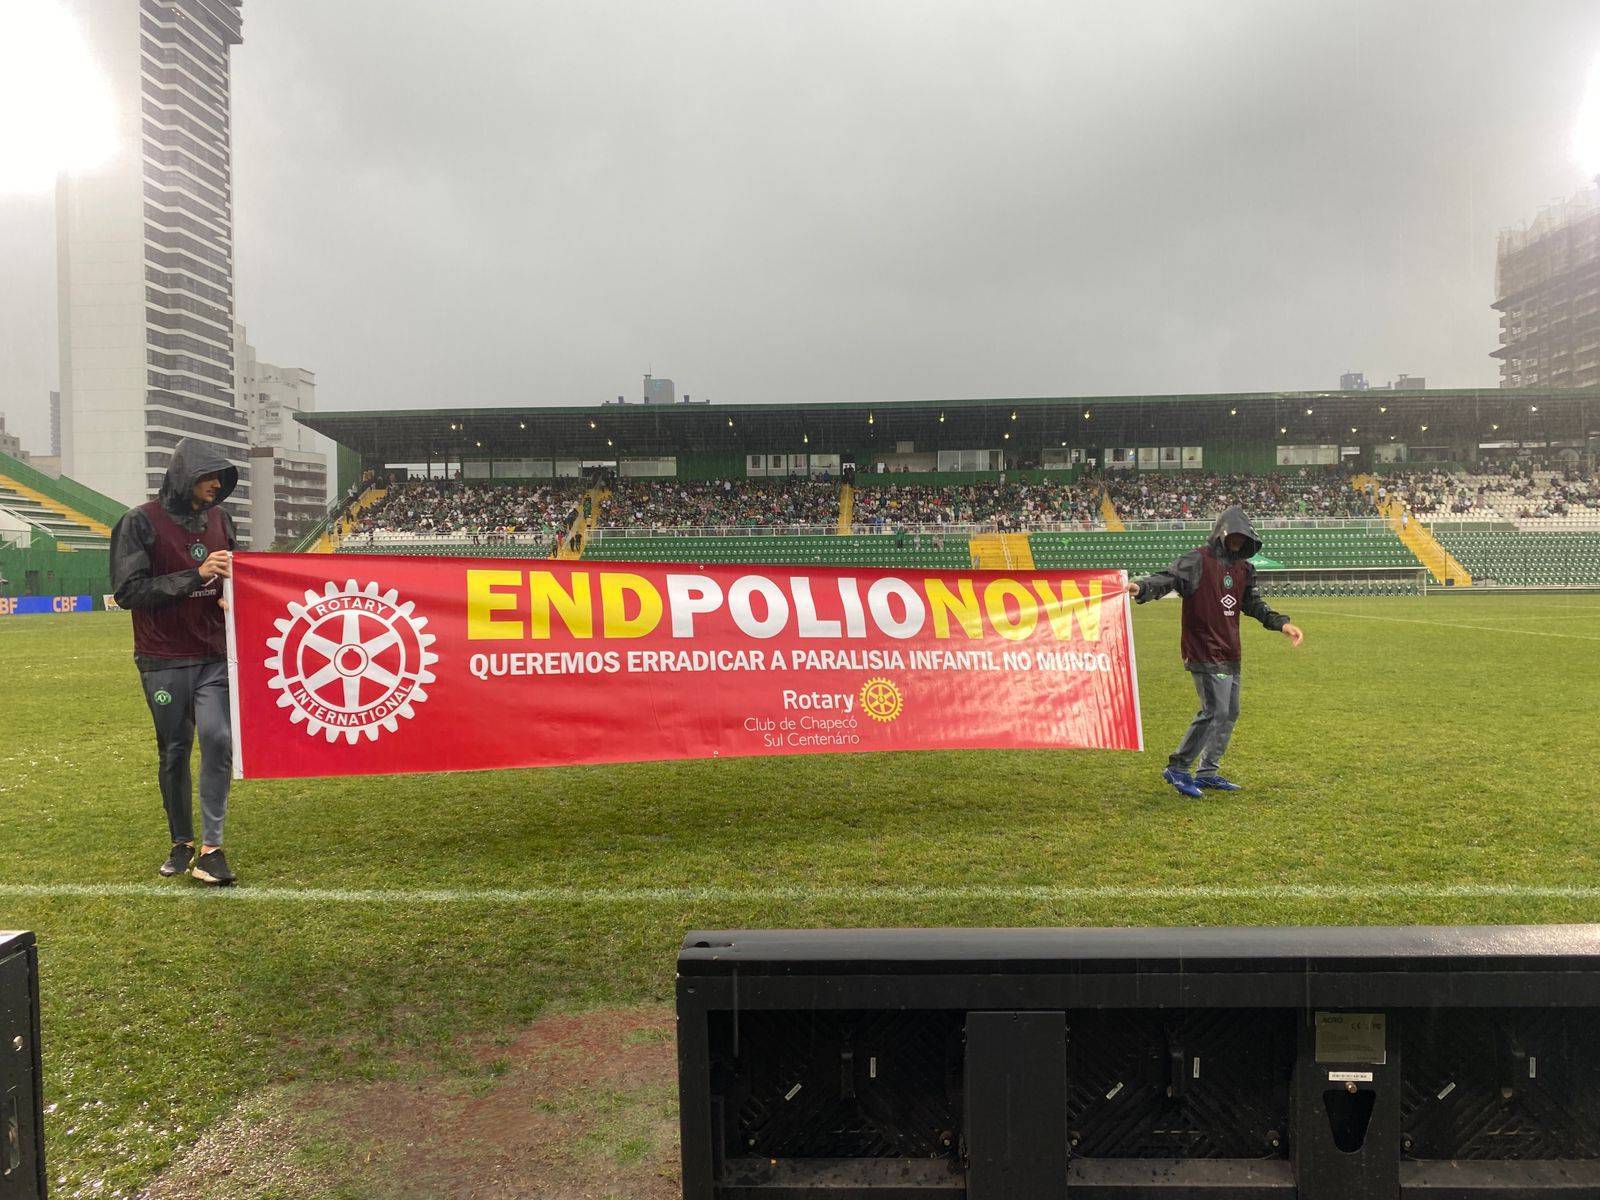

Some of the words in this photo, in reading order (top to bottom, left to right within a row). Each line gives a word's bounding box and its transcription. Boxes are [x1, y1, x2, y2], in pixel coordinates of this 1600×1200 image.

[52, 596, 78, 613] CBF
[315, 598, 388, 616] ROTARY
[469, 651, 621, 680] QUEREMOS
[627, 650, 766, 672] ERRADICAR
[770, 650, 787, 670] A
[792, 650, 905, 670] PARALISIA
[910, 650, 1000, 671] INFANTIL
[1003, 651, 1032, 671] NO
[1037, 652, 1111, 672] MUNDO
[293, 684, 413, 725] INTERNATIONAL
[782, 689, 854, 713] Rotary
[744, 717, 775, 731] Club
[780, 716, 796, 729] de
[800, 716, 857, 732] Chapecó
[764, 733, 783, 747] Sul
[787, 732, 860, 746] Centenário
